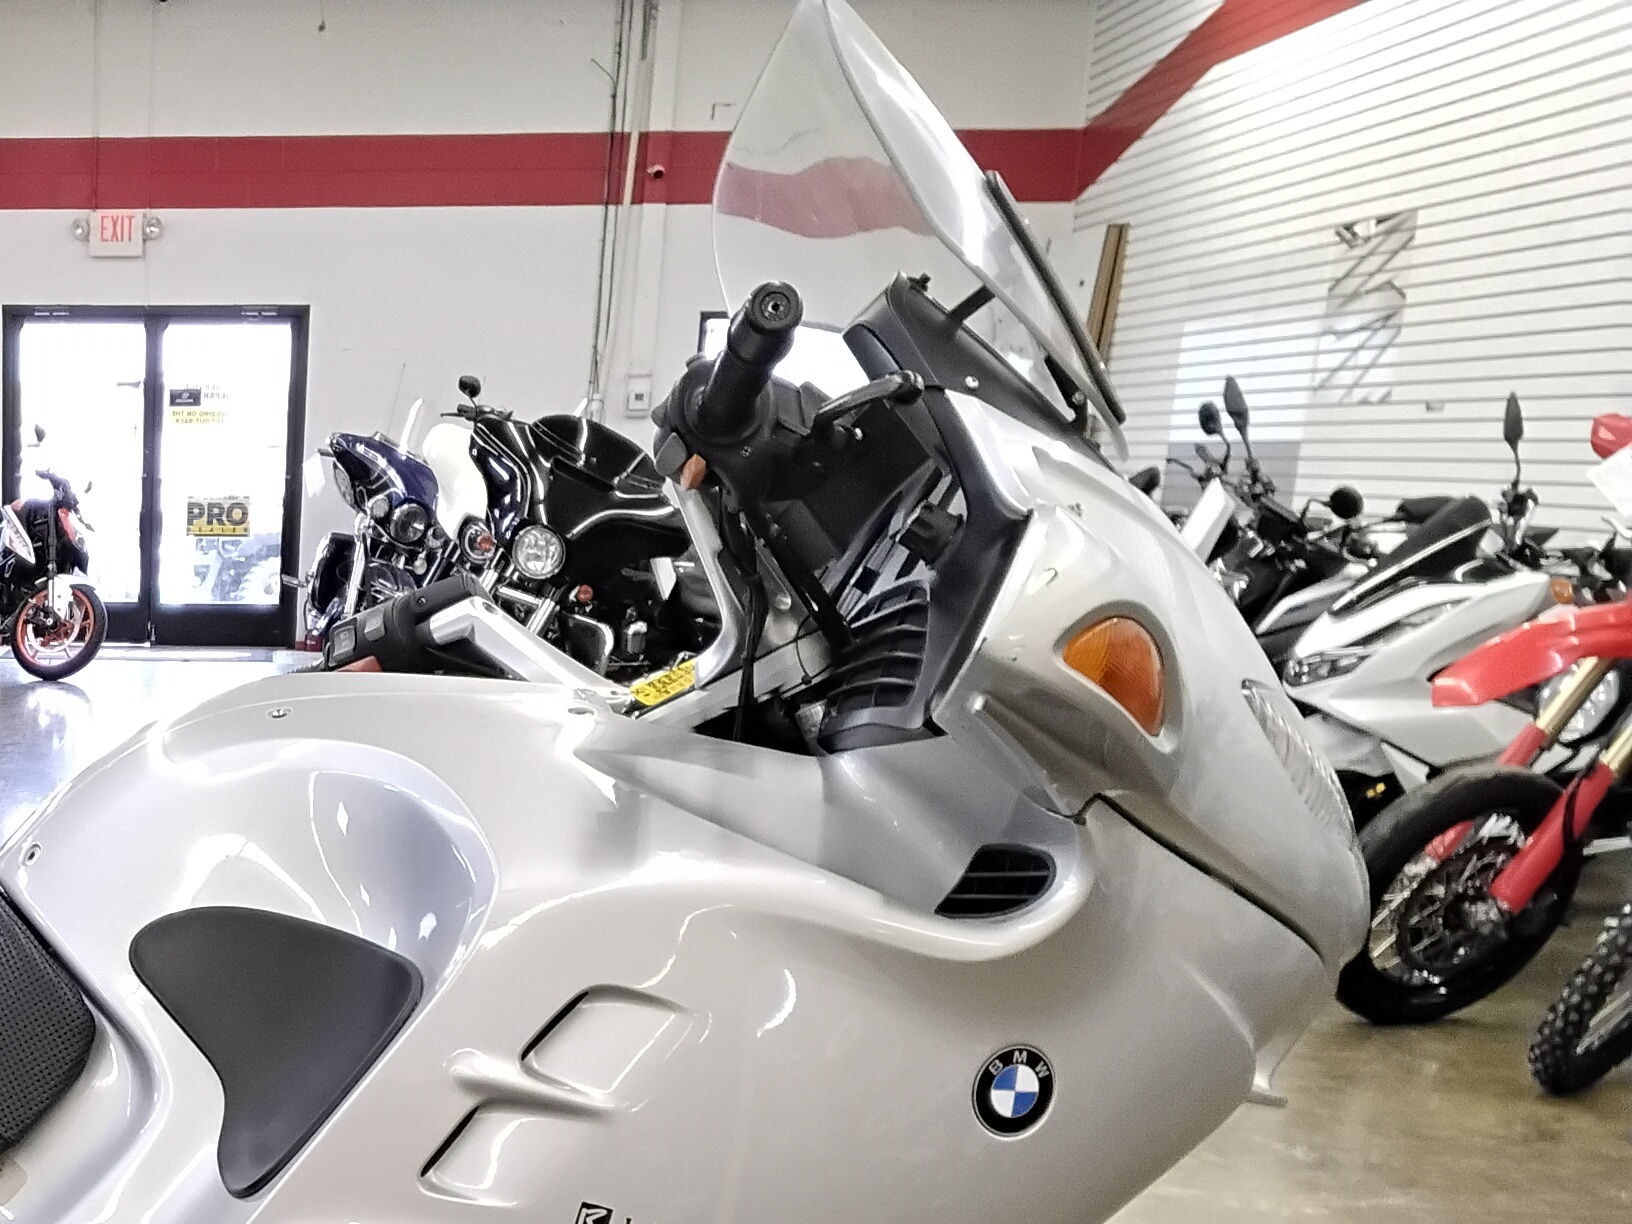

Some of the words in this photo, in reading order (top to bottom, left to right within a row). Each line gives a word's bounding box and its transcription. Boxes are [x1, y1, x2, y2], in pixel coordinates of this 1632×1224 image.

[99, 215, 135, 242] EXIT
[187, 502, 249, 526] PRO
[988, 1049, 1050, 1079] BMW
